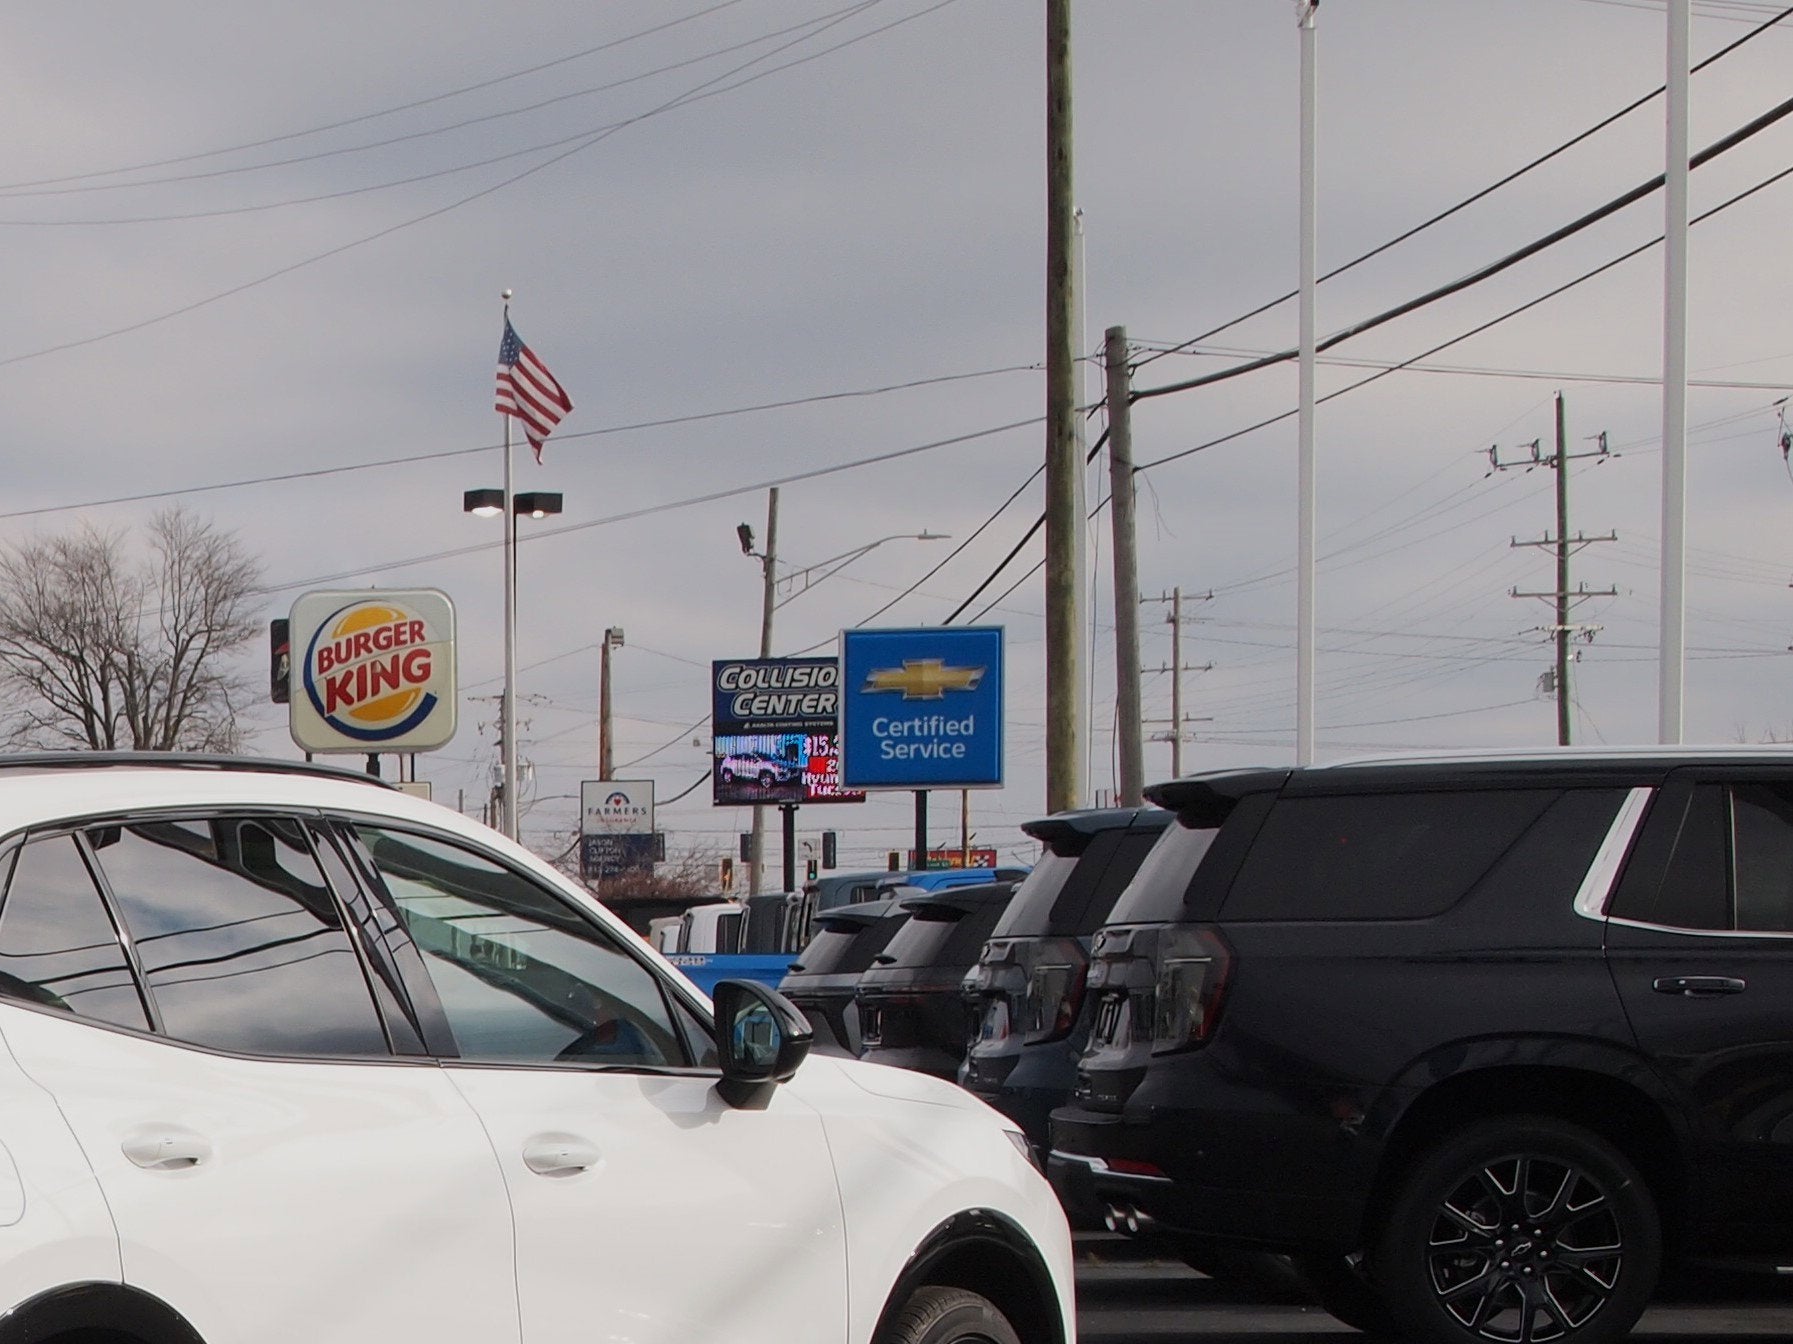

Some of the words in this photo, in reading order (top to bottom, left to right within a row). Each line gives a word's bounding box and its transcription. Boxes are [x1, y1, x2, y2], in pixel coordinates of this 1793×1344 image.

[317, 620, 426, 675] BURGER
[325, 648, 432, 714] KING
[719, 666, 838, 690] COLLISIO
[733, 692, 836, 716] CENTER
[872, 714, 975, 737] Certified
[880, 738, 966, 759] Service
[587, 806, 648, 816] FARMERS
